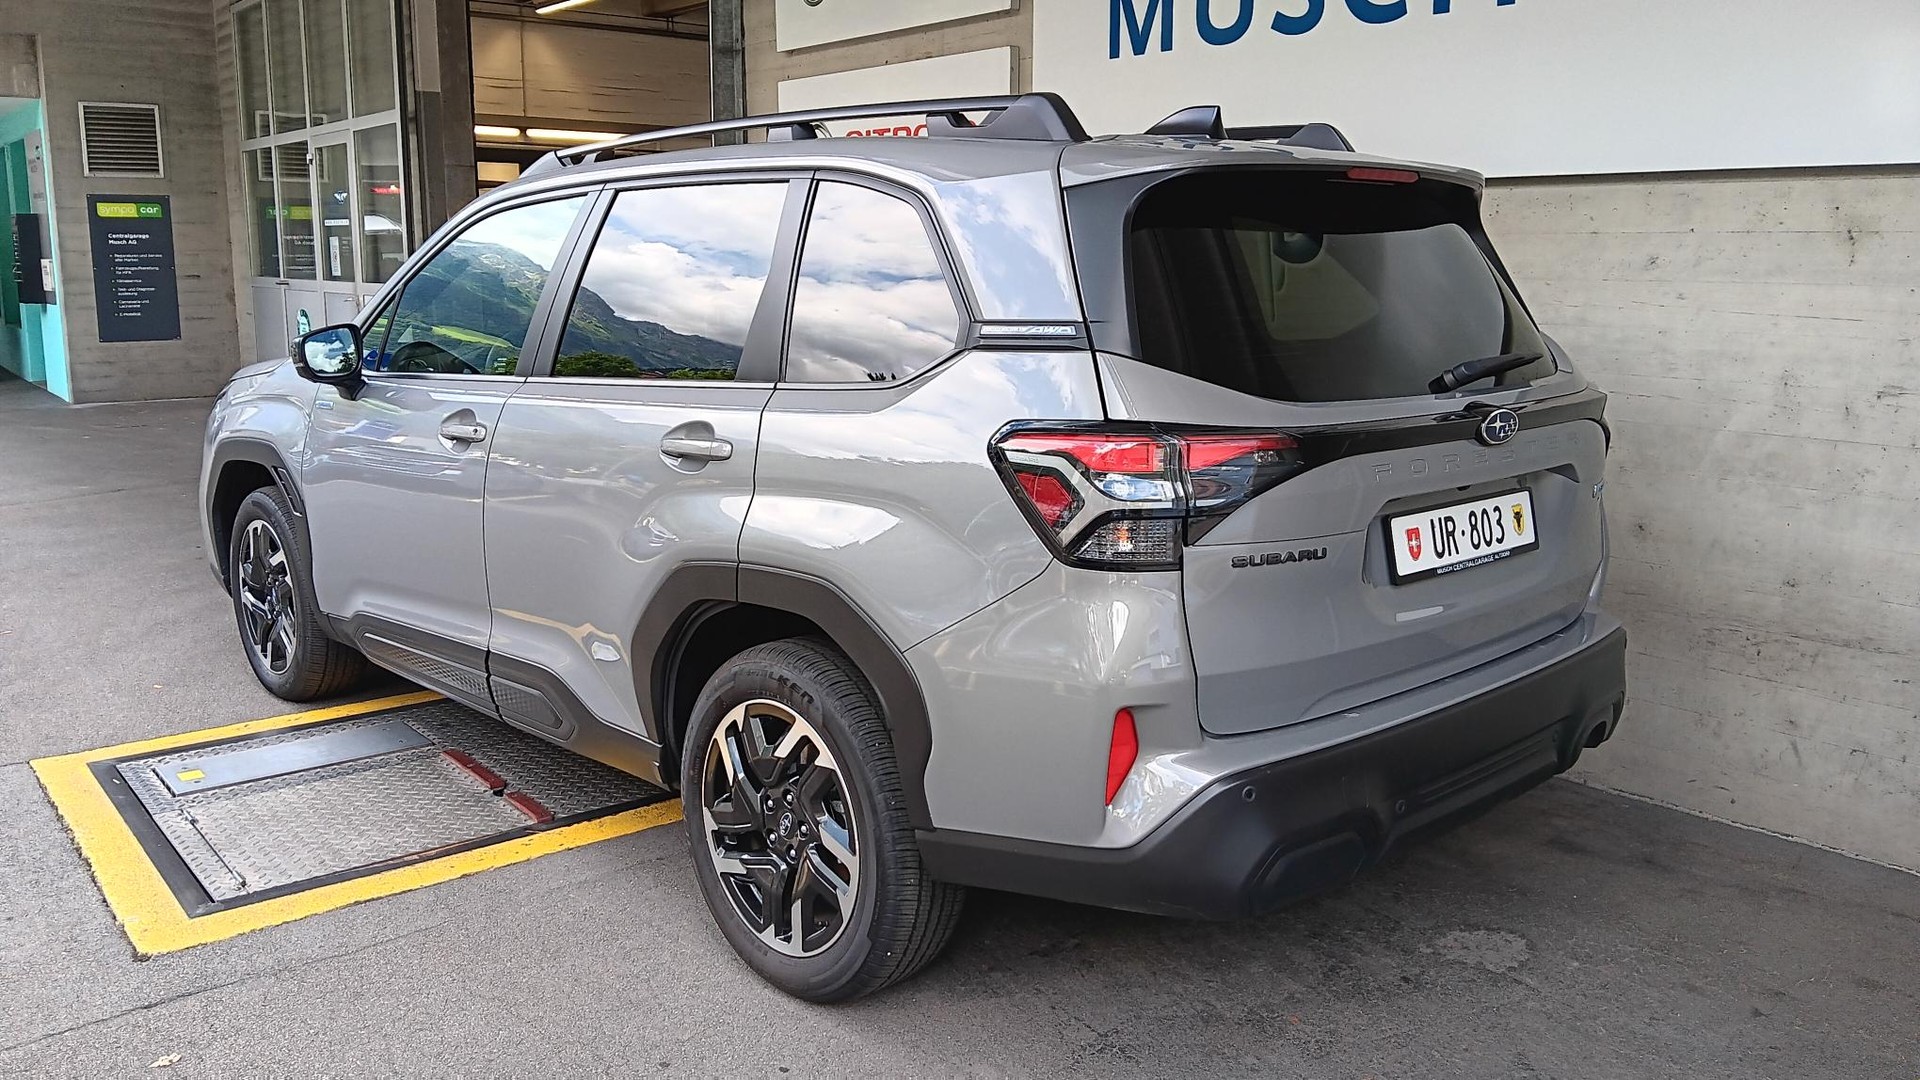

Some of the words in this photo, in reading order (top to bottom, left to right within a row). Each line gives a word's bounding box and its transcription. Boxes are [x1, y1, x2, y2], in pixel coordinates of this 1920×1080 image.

[1371, 431, 1583, 483] FORESTER
[1231, 547, 1328, 569] SUBARU
[1453, 554, 1494, 570] CENTRALGARAGE
